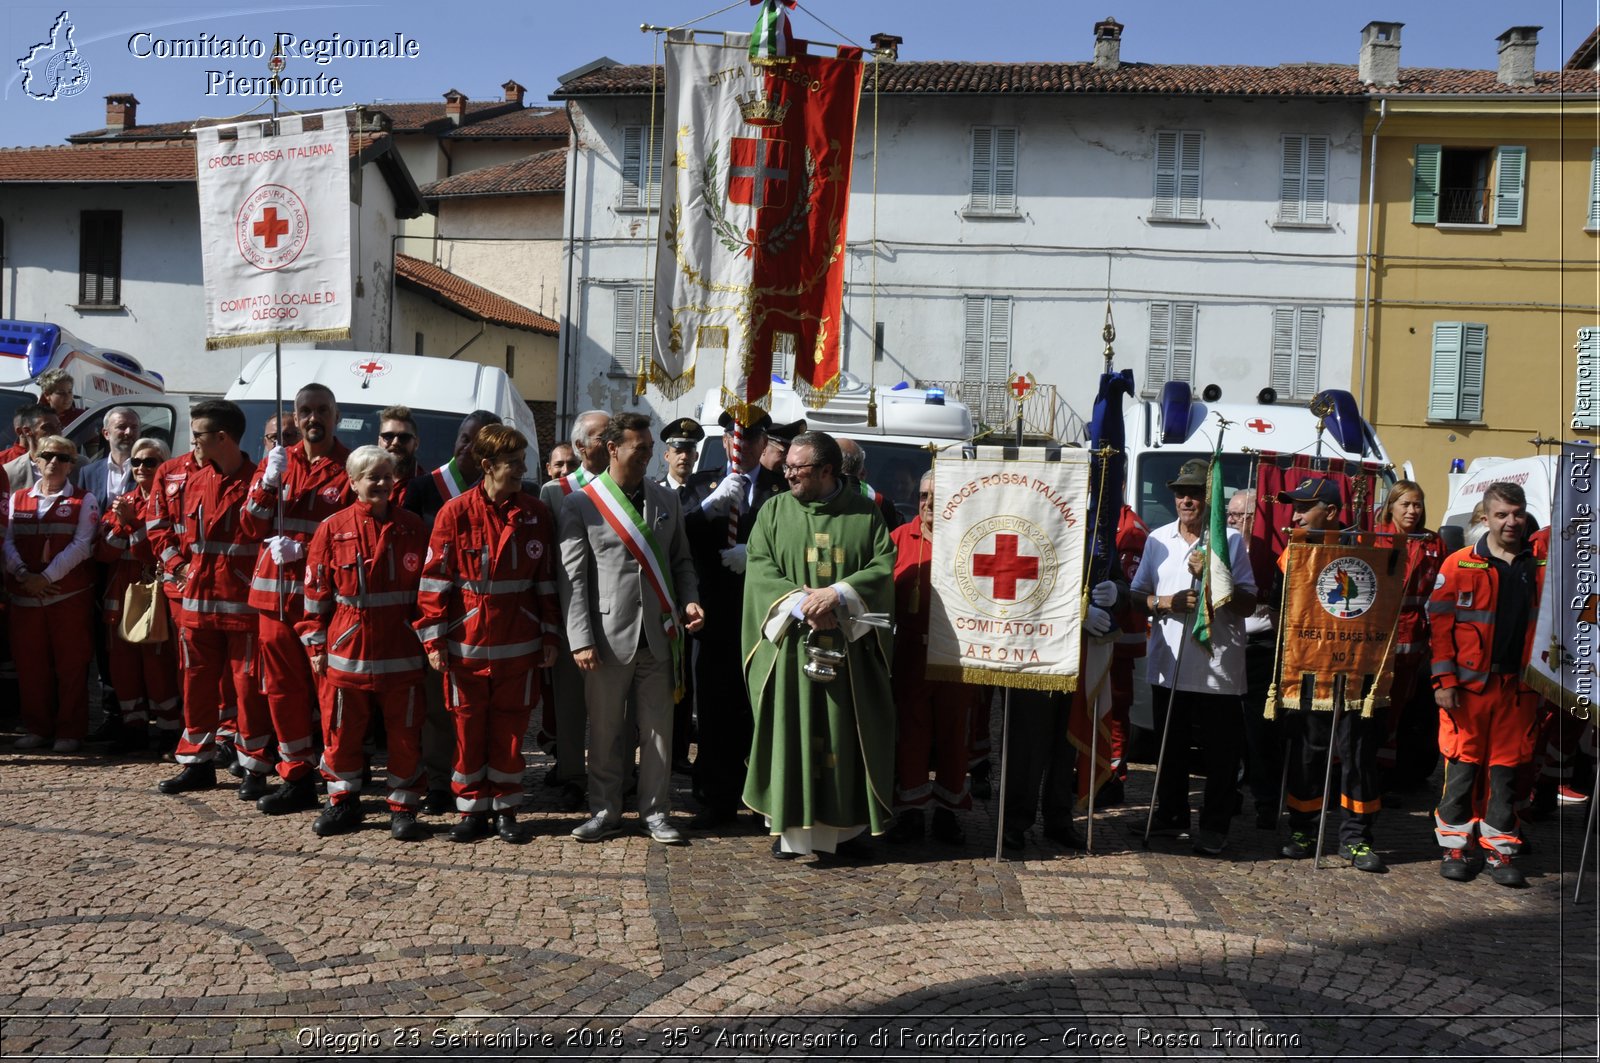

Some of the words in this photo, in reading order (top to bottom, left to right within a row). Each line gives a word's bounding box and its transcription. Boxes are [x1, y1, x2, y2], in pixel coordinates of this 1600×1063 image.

[208, 154, 245, 169] CROCE
[248, 149, 284, 164] ROSSA
[287, 143, 334, 160] ITALIANA
[287, 197, 297, 208] 22
[294, 208, 304, 248] AGOSTO
[220, 294, 270, 312] COMITATO
[274, 292, 322, 305] LOCALE
[325, 292, 335, 303] DI
[252, 307, 298, 321] OLEGGIO
[942, 481, 979, 521] CROCE
[981, 473, 1028, 488] ROSSA
[1031, 479, 1077, 528] ITALIANA
[957, 532, 979, 602] CONVENZIONE
[976, 526, 988, 536] DI
[988, 519, 1031, 534] GINEVRA
[1032, 530, 1045, 542] 22
[1041, 543, 1056, 586] AGOSTO
[1323, 559, 1355, 576] VOLONTARI
[956, 617, 1034, 635] COMITATO
[1039, 623, 1053, 636] DI
[1298, 630, 1321, 640] AREA
[1326, 631, 1336, 641] DI
[1340, 632, 1363, 642] BASE
[965, 643, 1040, 663] ARONA
[1332, 652, 1345, 662] NO
